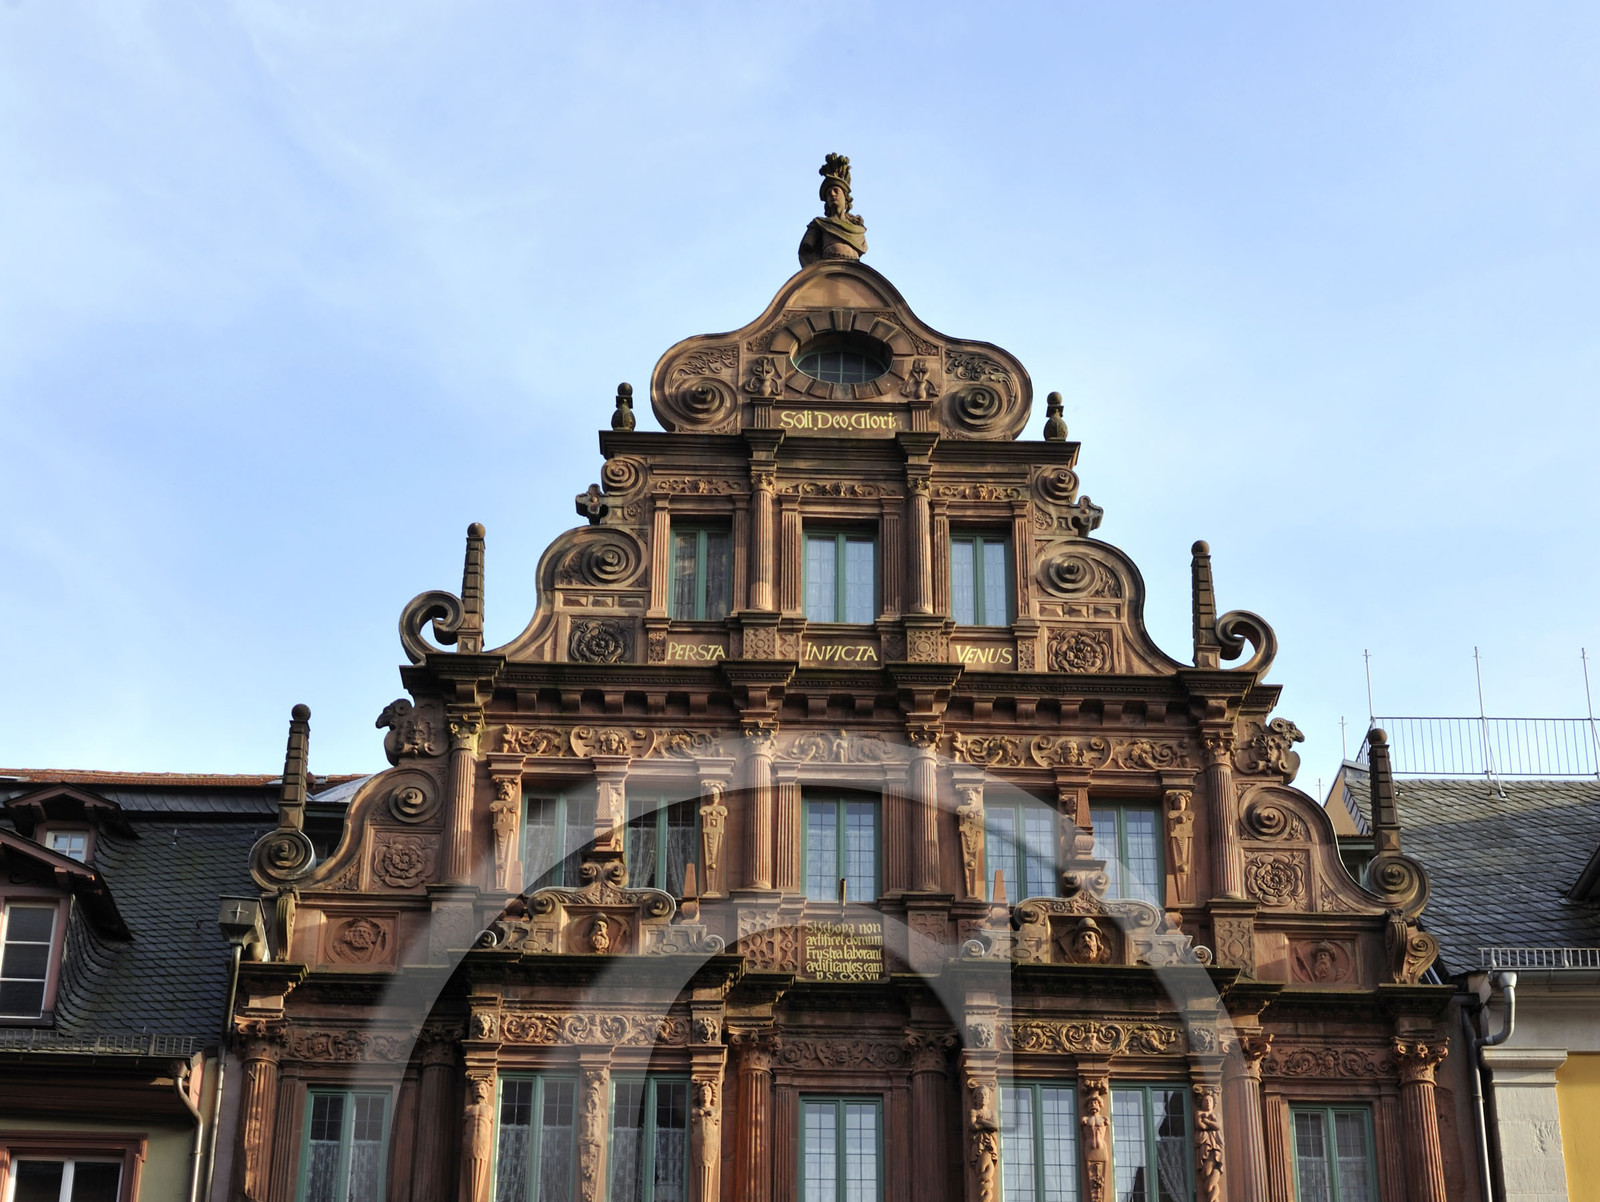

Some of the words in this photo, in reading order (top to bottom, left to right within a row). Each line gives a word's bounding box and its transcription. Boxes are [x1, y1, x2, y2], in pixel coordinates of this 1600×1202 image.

[667, 643, 726, 661] PERSTA
[804, 642, 878, 662] INVICTA
[954, 644, 1013, 664] VENUS
[859, 923, 882, 934] non
[806, 946, 843, 960] Frustra
[844, 944, 882, 960] laborant
[863, 961, 883, 973] eam
